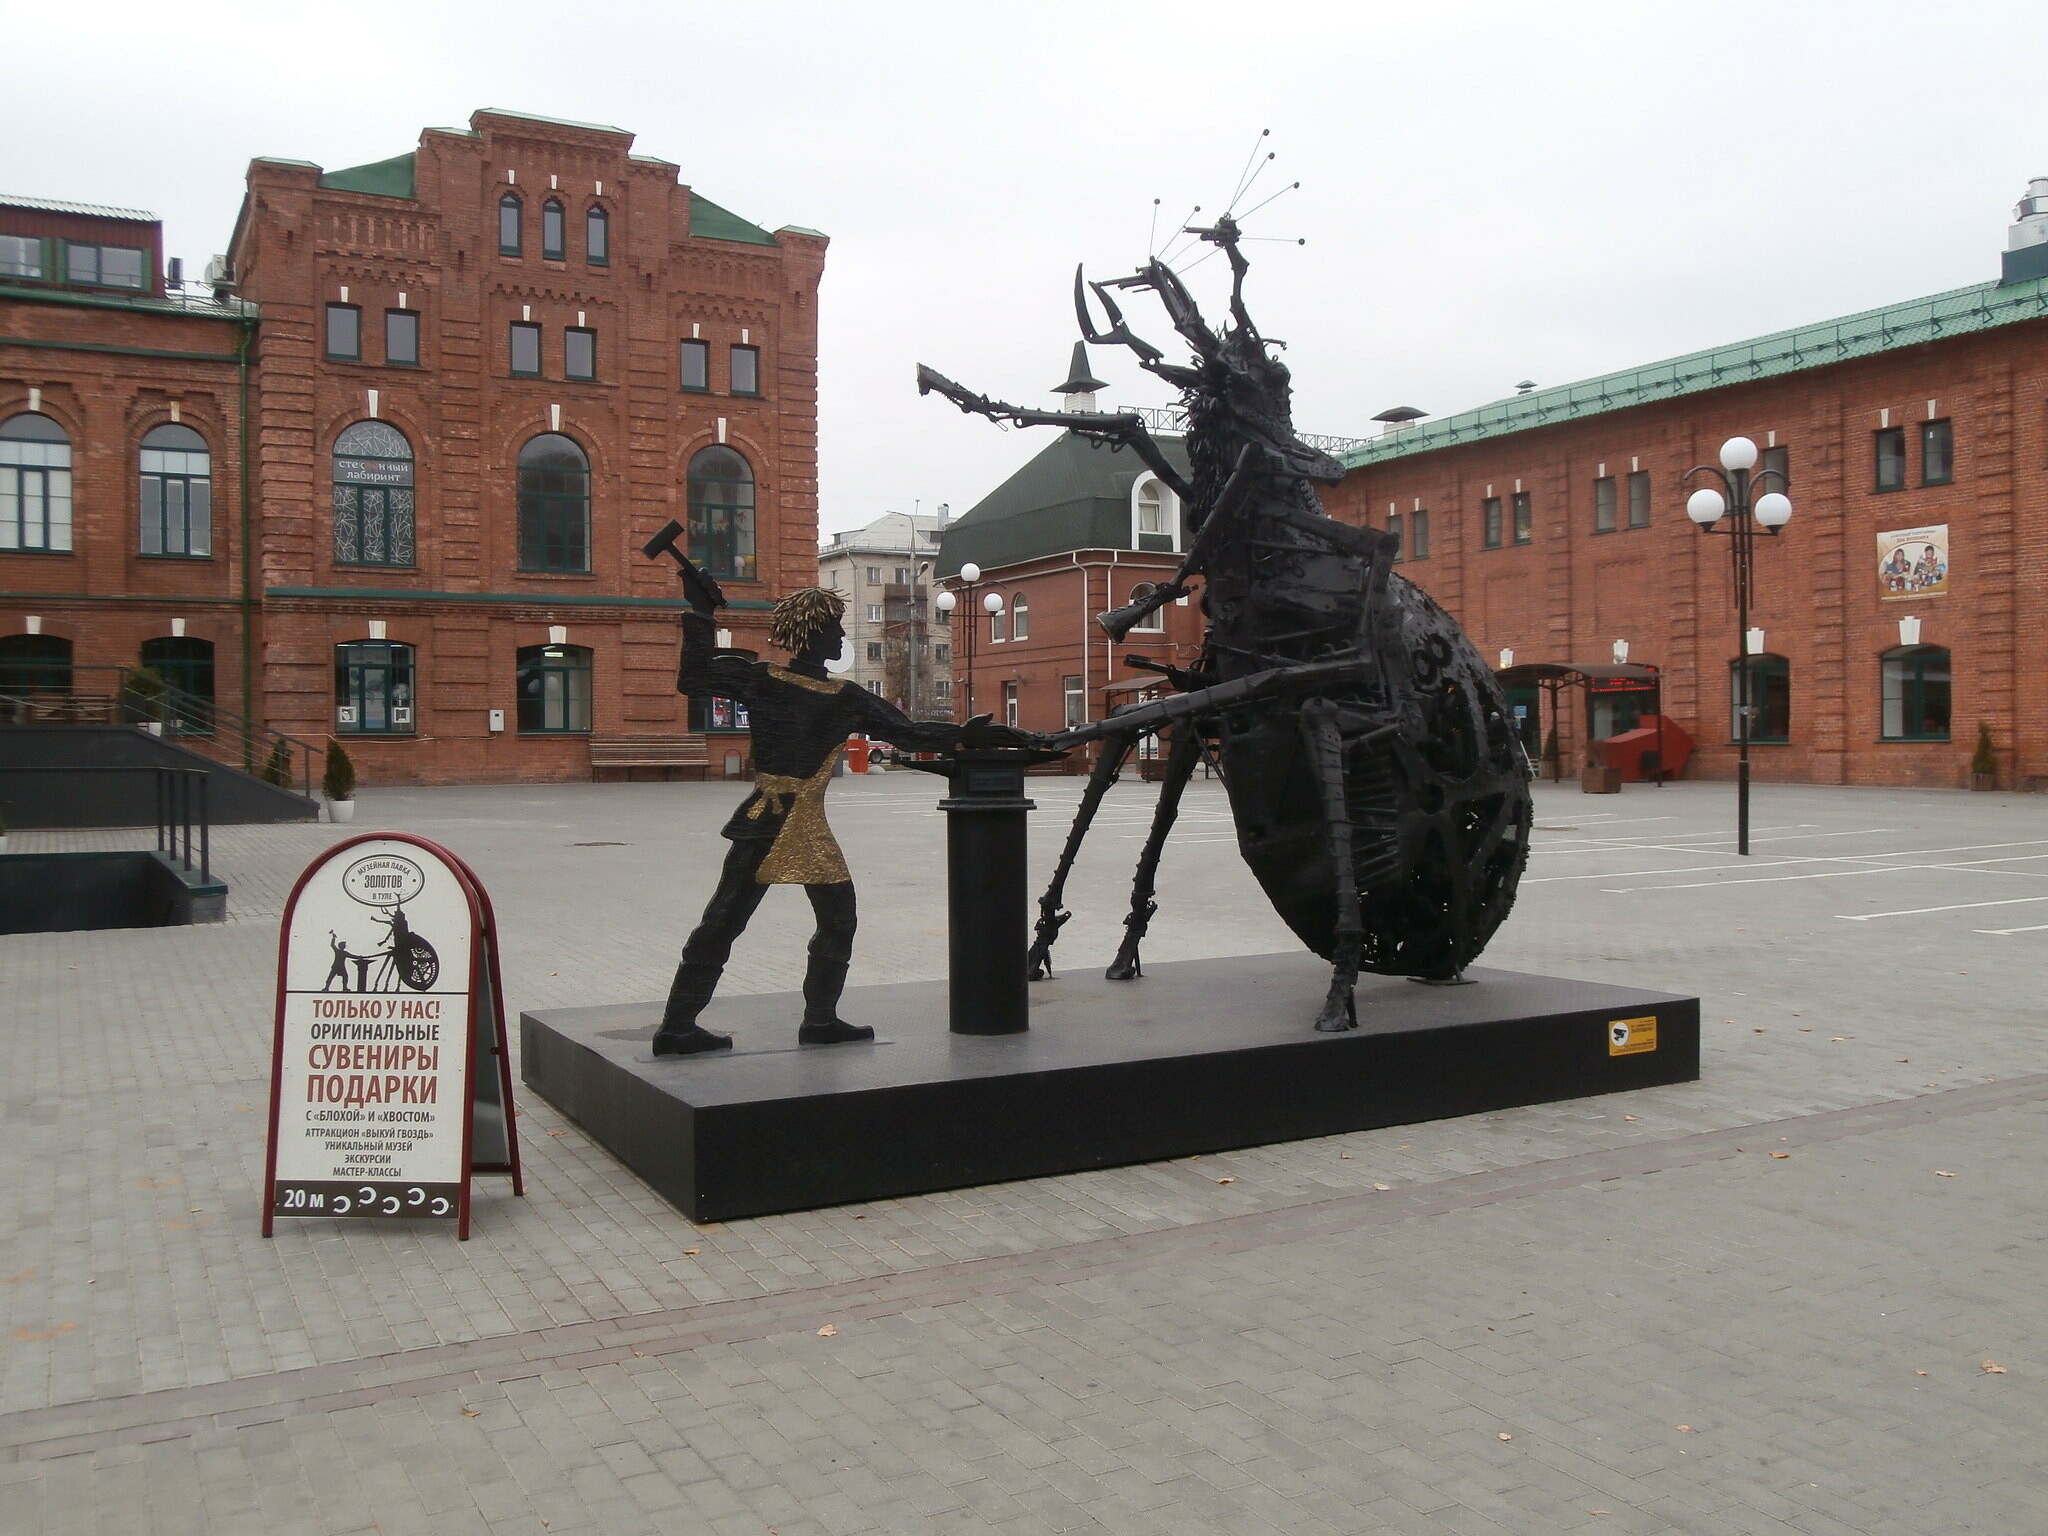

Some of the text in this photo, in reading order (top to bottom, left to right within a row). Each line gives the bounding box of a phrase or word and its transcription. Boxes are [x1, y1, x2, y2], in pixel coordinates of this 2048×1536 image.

[347, 470, 401, 482] лабиринт
[357, 861, 411, 876] МУЗЕЙНАЯ ЛАВКА
[364, 875, 402, 888] ЗОЛОТОВ
[313, 999, 440, 1019] ТОЛЬКО У НАС!
[311, 1023, 440, 1041] ОРИГИНАЛЬНЫЕ
[308, 1044, 439, 1070] СУВЕНИРЫ
[307, 1074, 437, 1109] ПОДАРКИ
[306, 1109, 435, 1123] С «БЛОХОЙ» И «ХВОСТОМ»
[305, 1127, 434, 1140] АТТРАКЦИОН «ВЫКУЙ ГВОЗДЬ»
[324, 1139, 413, 1151] УНИКАЛЬНЫЙ МУЗЕЙ
[345, 1154, 391, 1164] ЭКСКУРСИИ
[332, 1167, 401, 1177] МАСТЕР-КЛАССЫ
[284, 1189, 324, 1208] 20 м
